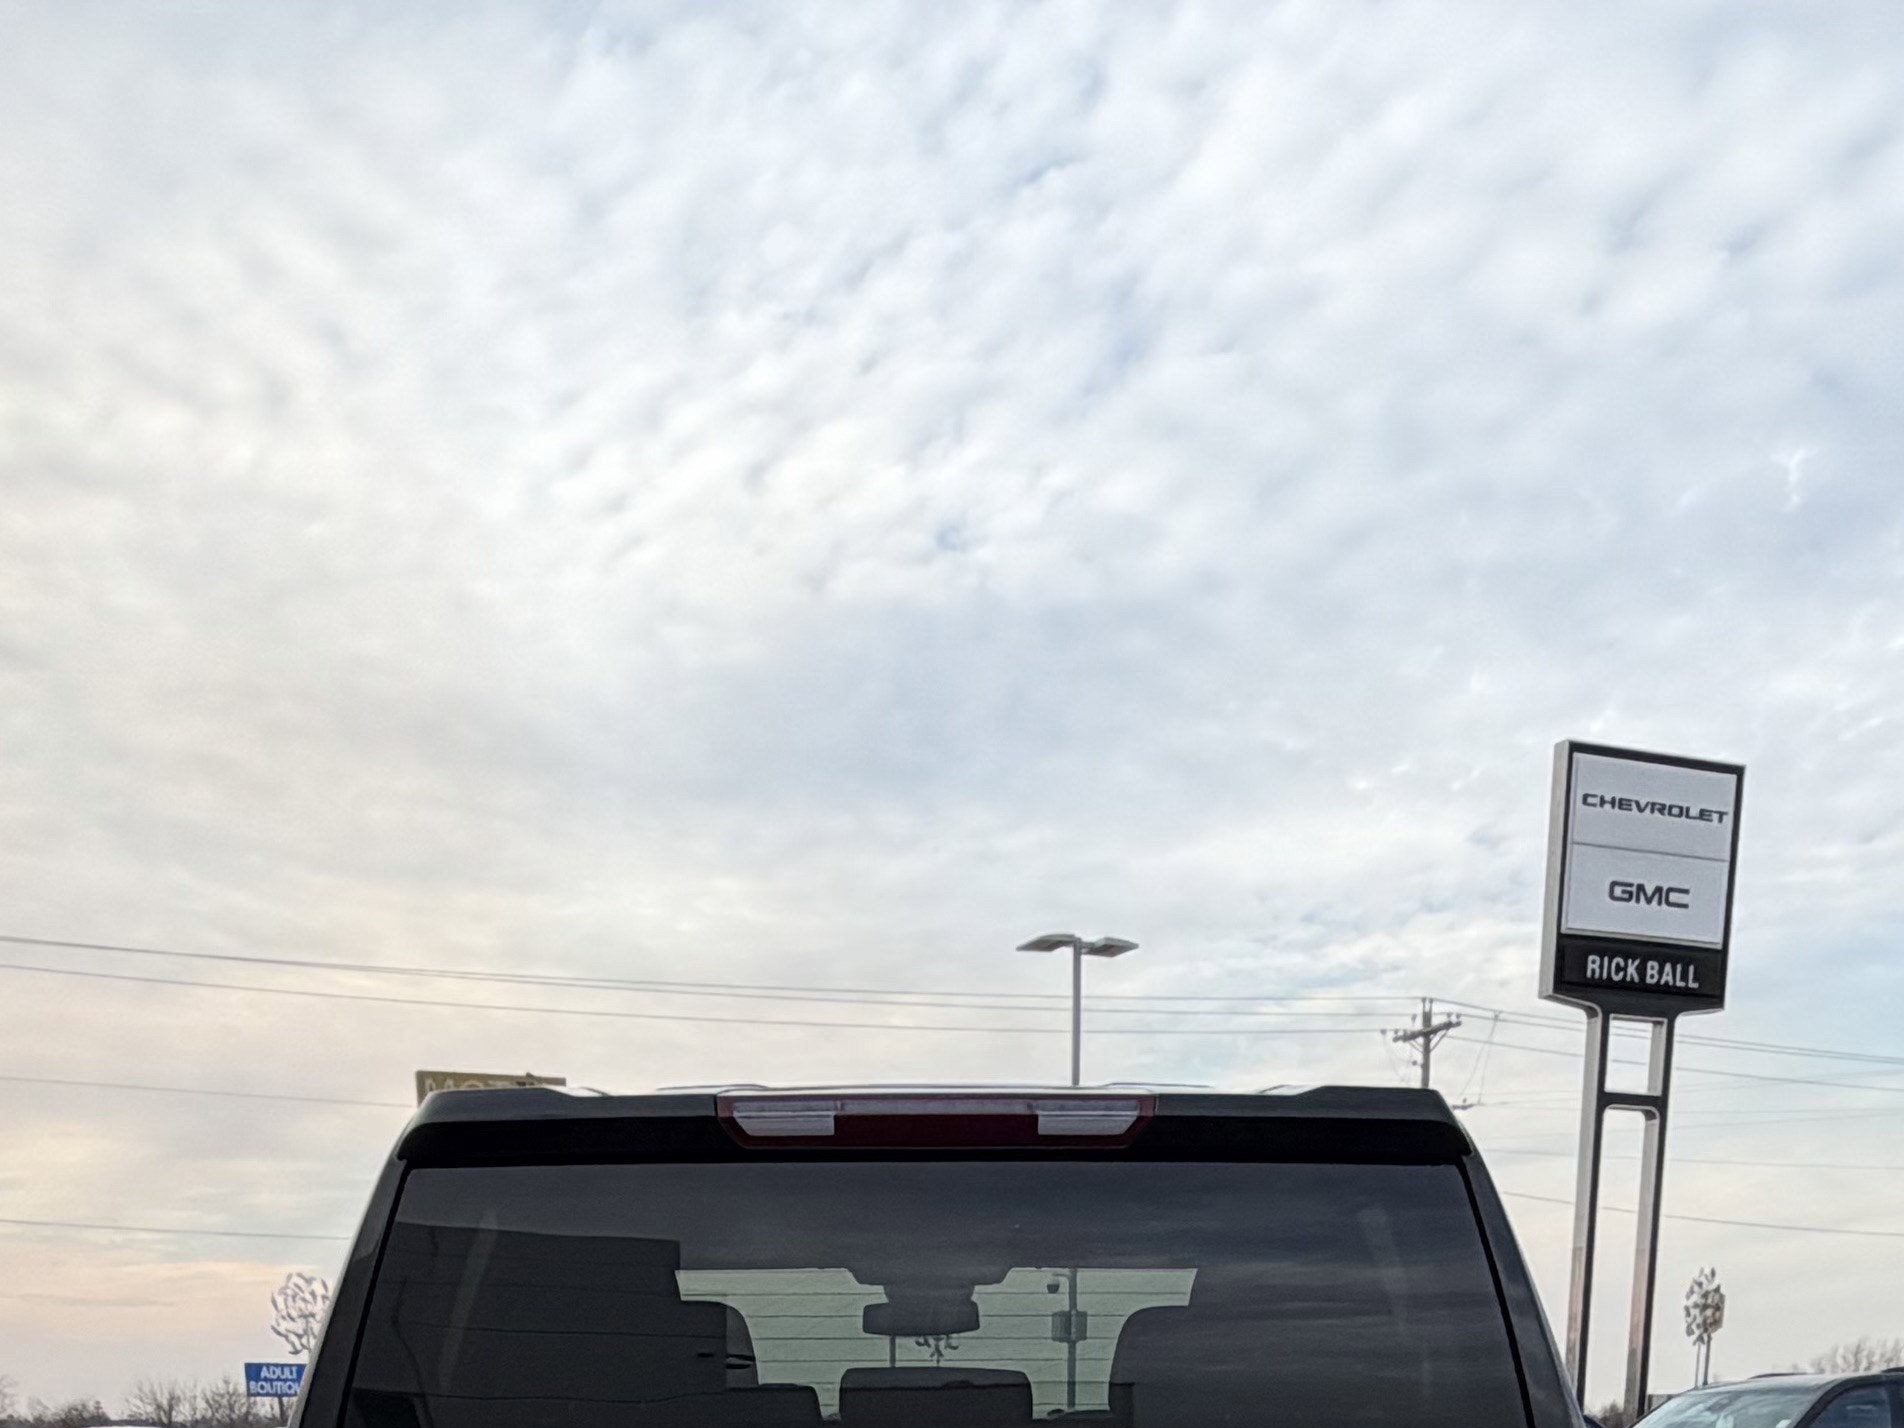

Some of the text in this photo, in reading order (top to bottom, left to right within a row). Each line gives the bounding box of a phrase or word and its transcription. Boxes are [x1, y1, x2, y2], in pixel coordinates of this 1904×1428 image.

[1582, 792, 1729, 824] CHEVROLET
[1608, 879, 1691, 909] GMC
[1586, 954, 1699, 989] RICK BALL
[260, 1364, 298, 1380] ADULT
